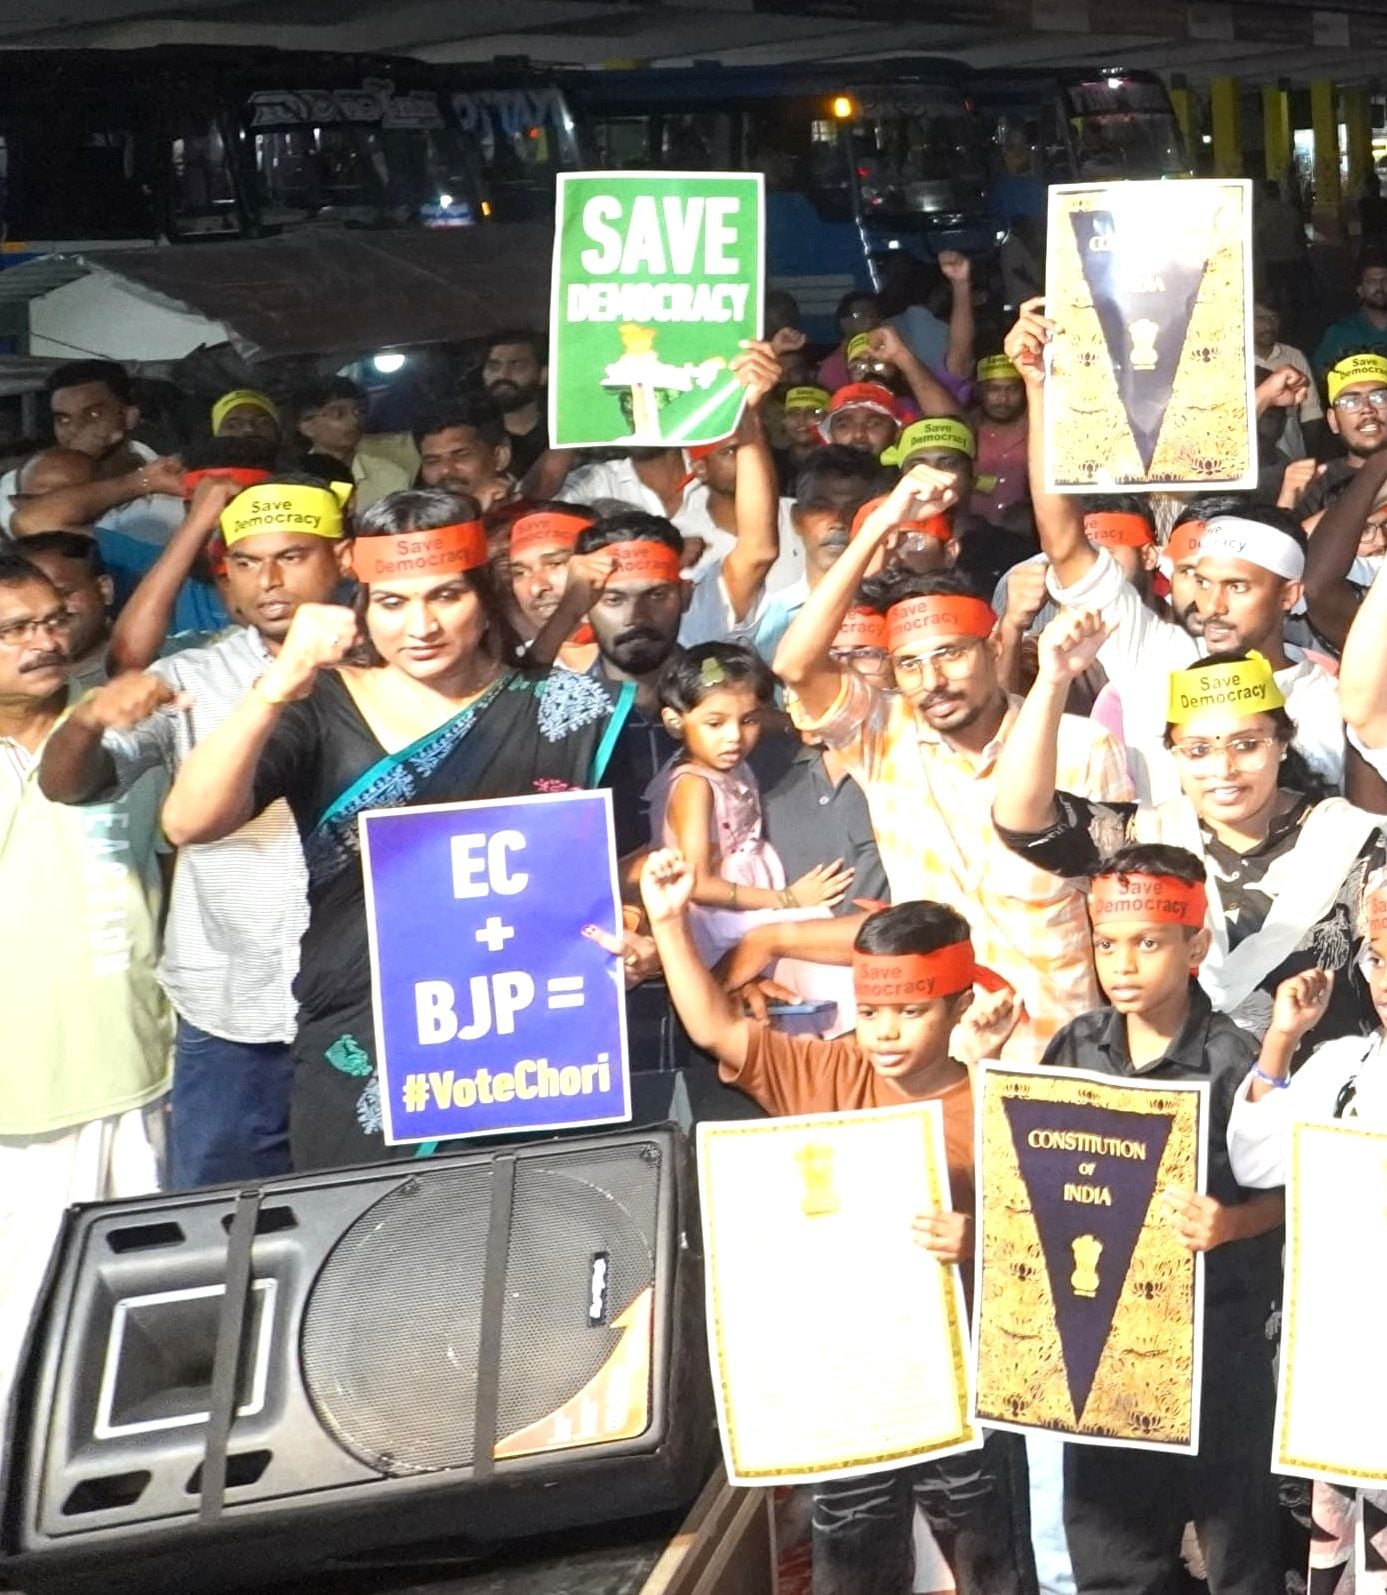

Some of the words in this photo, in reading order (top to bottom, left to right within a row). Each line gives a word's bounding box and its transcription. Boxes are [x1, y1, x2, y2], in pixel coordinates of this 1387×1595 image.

[581, 195, 741, 275] SAVE
[567, 282, 750, 322] DEMOCRACY
[1353, 358, 1378, 367] Save
[924, 424, 952, 433] Save
[252, 500, 293, 513] Save
[234, 513, 322, 532] Democracy
[1086, 528, 1125, 542] cracy
[397, 538, 443, 556] Save
[841, 623, 884, 637] cracy
[894, 615, 959, 633] mocracy
[1200, 674, 1240, 691] Save
[1181, 683, 1267, 709] Democracy
[450, 829, 530, 900] EC
[84, 805, 131, 977] EACTION
[1119, 879, 1164, 896] Save
[475, 916, 515, 952] +
[860, 962, 902, 979] Save
[859, 977, 936, 997] mocracy
[414, 971, 535, 1046] BJP
[547, 976, 585, 1009] =
[402, 1052, 611, 1113] #VoteChori
[1028, 1129, 1147, 1162] CONSTITUTION
[1063, 1183, 1112, 1207] INDIA
